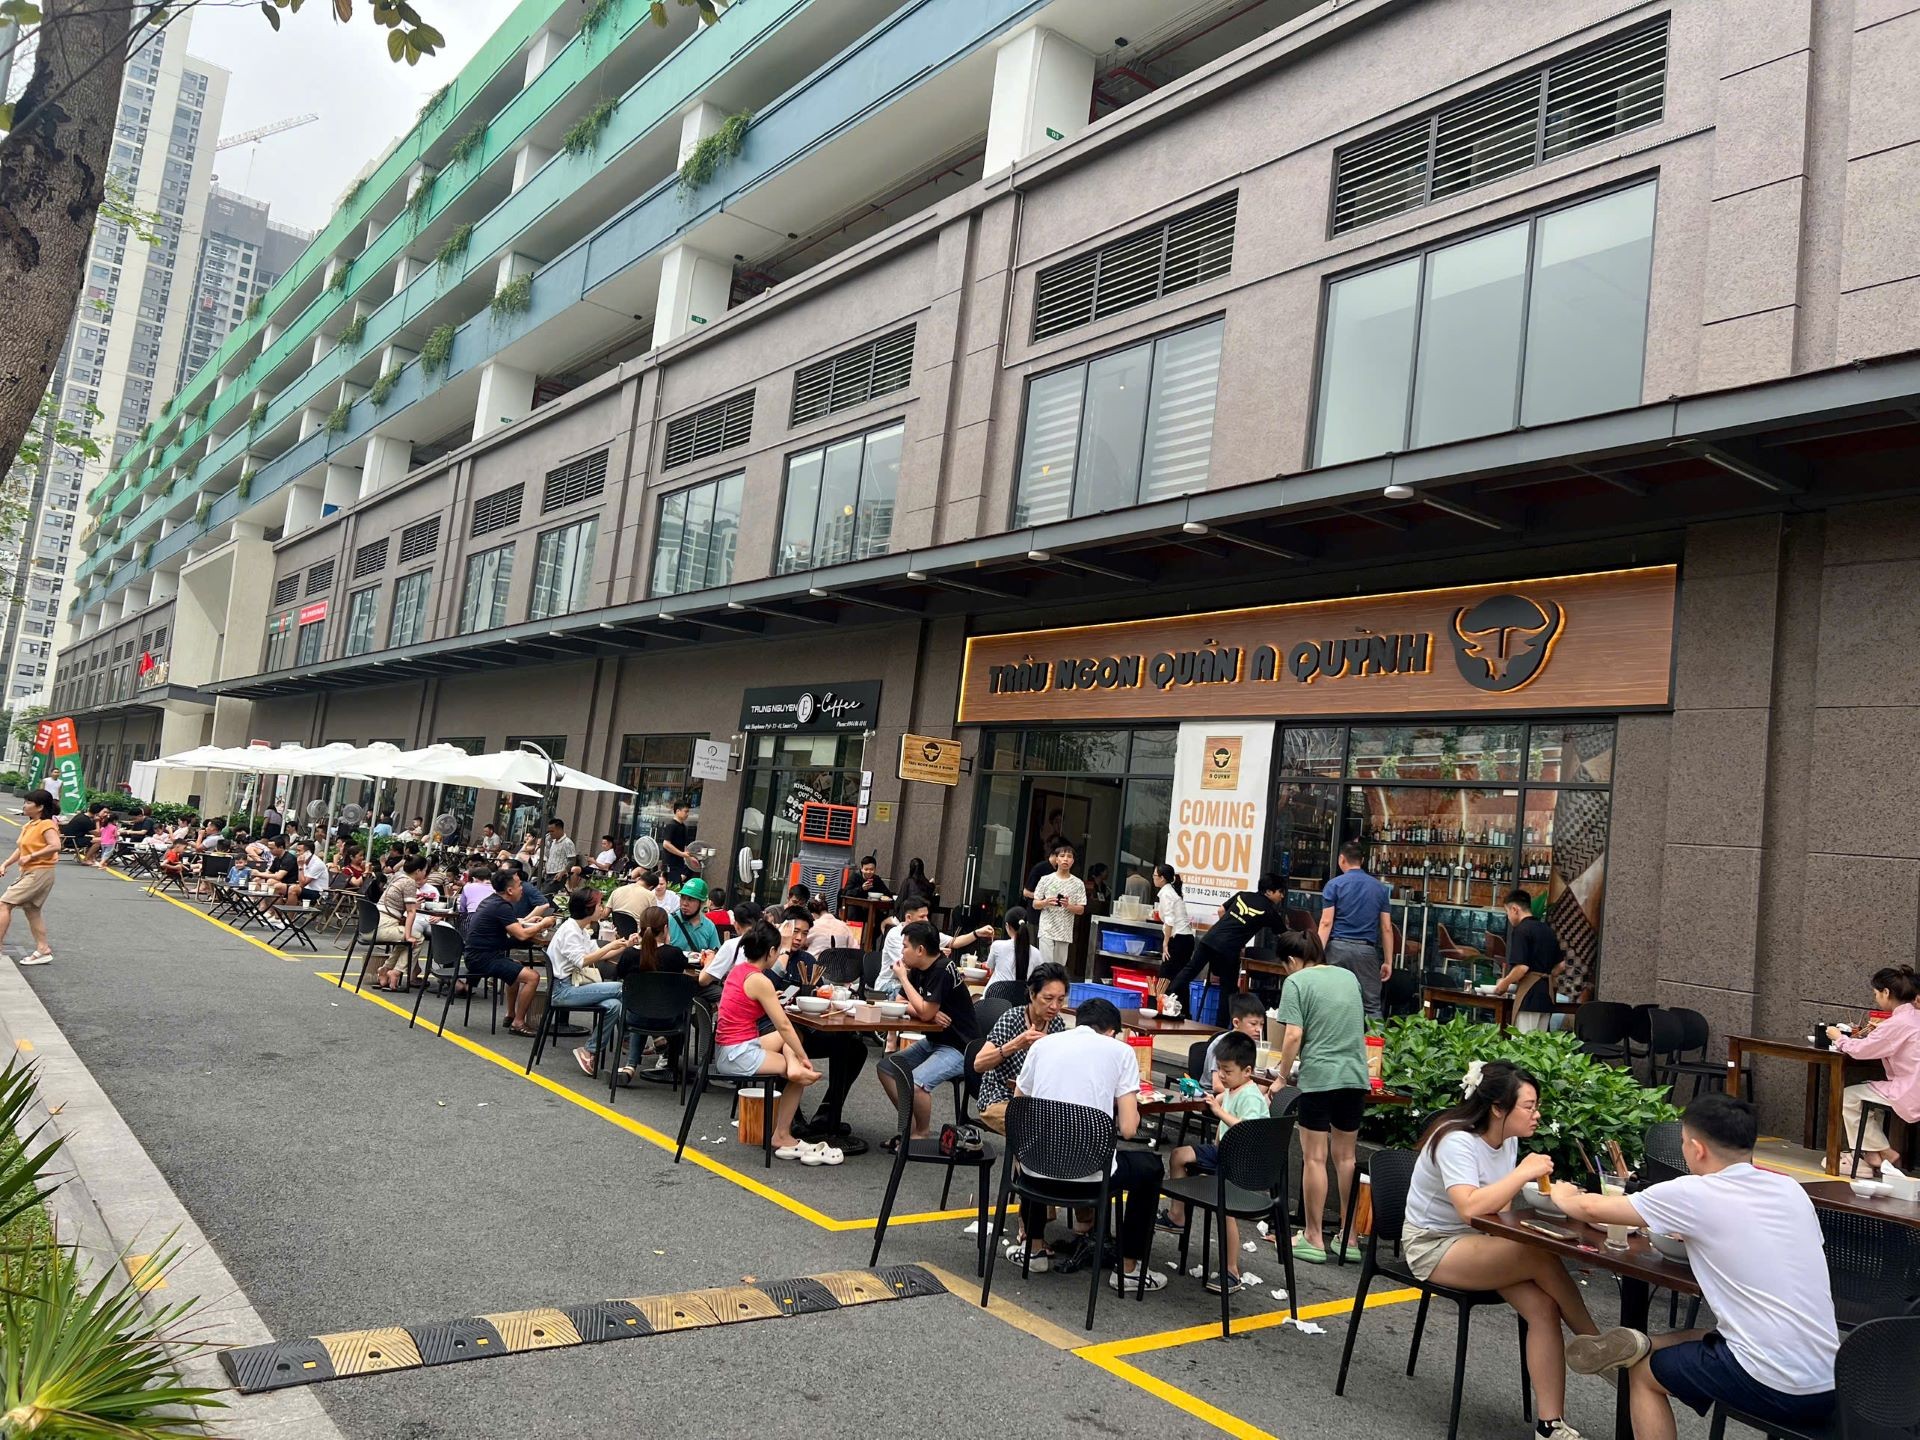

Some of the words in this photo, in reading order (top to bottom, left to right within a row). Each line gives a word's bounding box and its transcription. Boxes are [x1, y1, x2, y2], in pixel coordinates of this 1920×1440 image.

[1055, 656, 1142, 690] NGON
[1149, 638, 1241, 690] QUÁN
[1250, 645, 1277, 681] A
[1288, 626, 1430, 683] QUỲNH
[751, 704, 772, 714] TRUNG
[37, 724, 53, 749] FIT
[57, 722, 72, 749] FIT
[61, 760, 80, 799] CITY
[1180, 799, 1255, 829] COMING
[1175, 829, 1252, 873] SOON
[1202, 876, 1215, 886] KHAI
